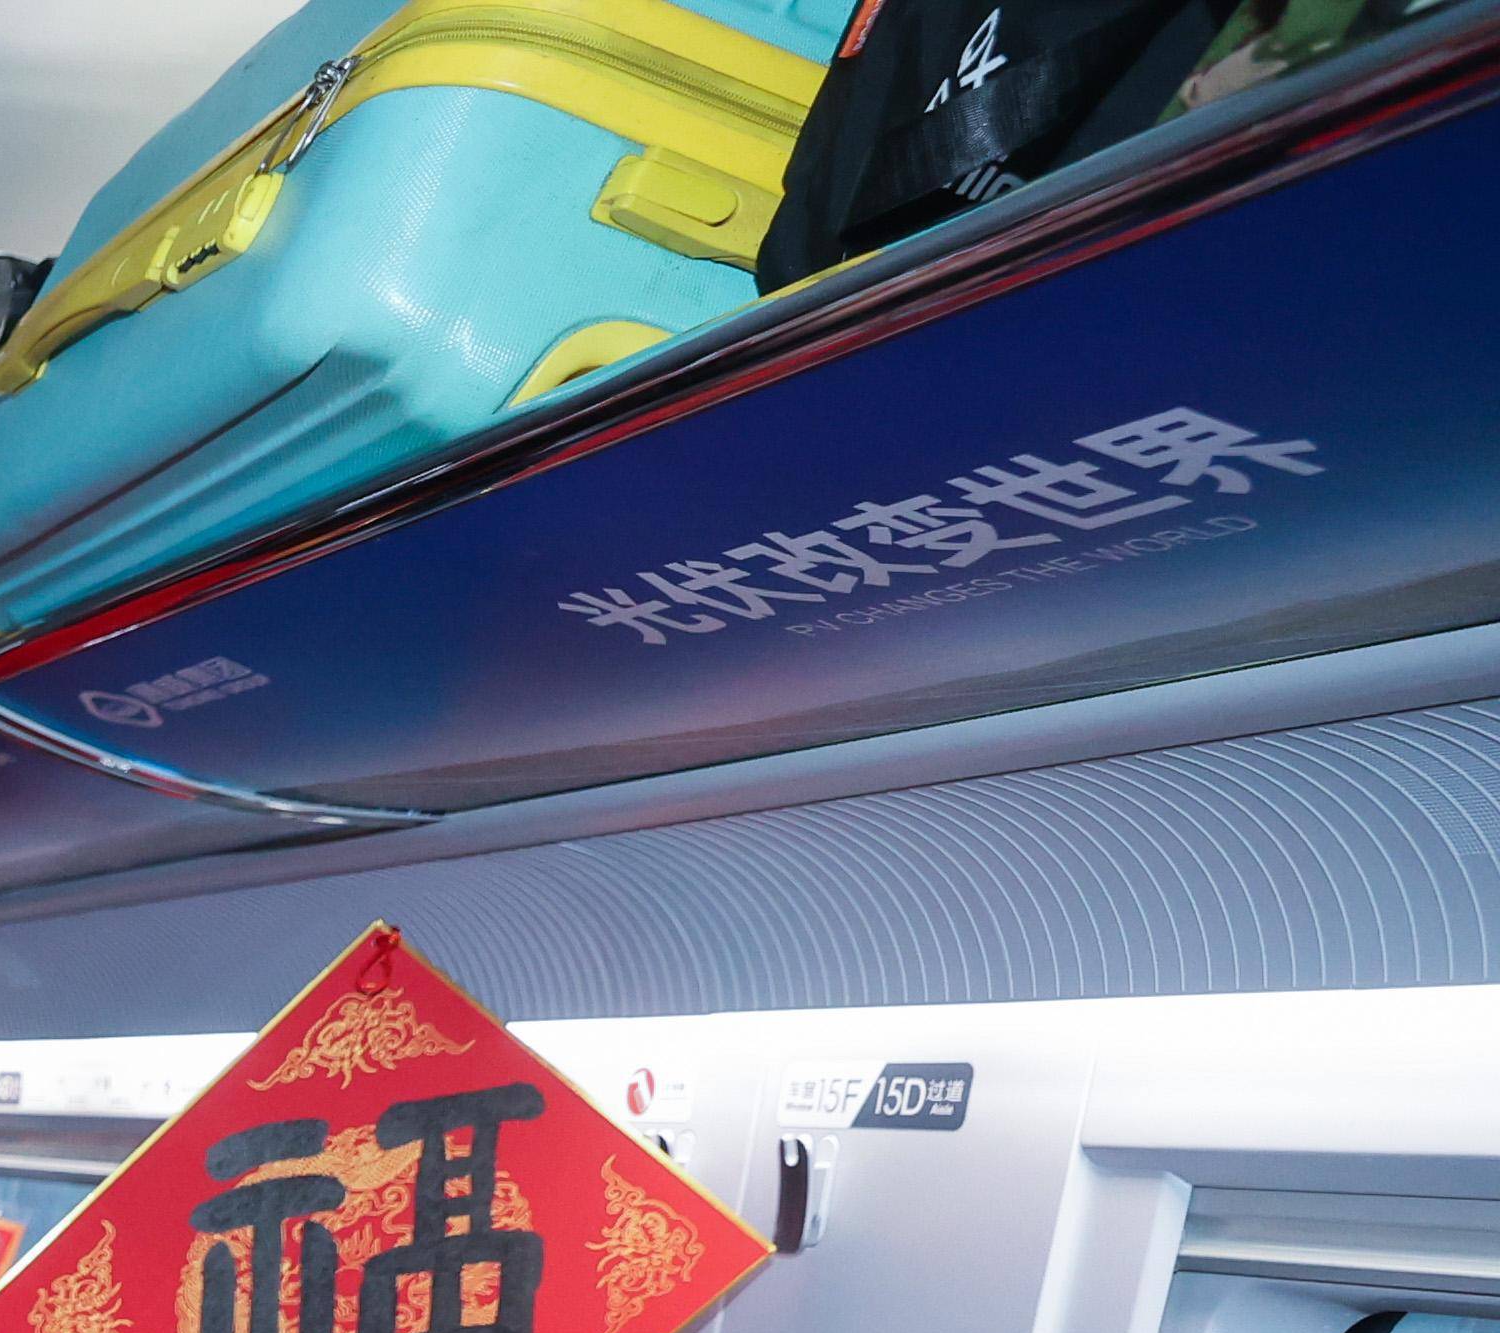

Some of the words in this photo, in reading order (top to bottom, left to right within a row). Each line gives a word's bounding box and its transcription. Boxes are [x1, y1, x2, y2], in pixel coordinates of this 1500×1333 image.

[558, 406, 1324, 646] 光伏改变世界
[836, 573, 1013, 626] CHANGES
[998, 557, 1095, 583] THE
[1081, 516, 1257, 562] WORLD
[817, 1079, 861, 1113] 15F
[875, 1076, 926, 1116] 15D
[927, 1079, 966, 1102] 过道
